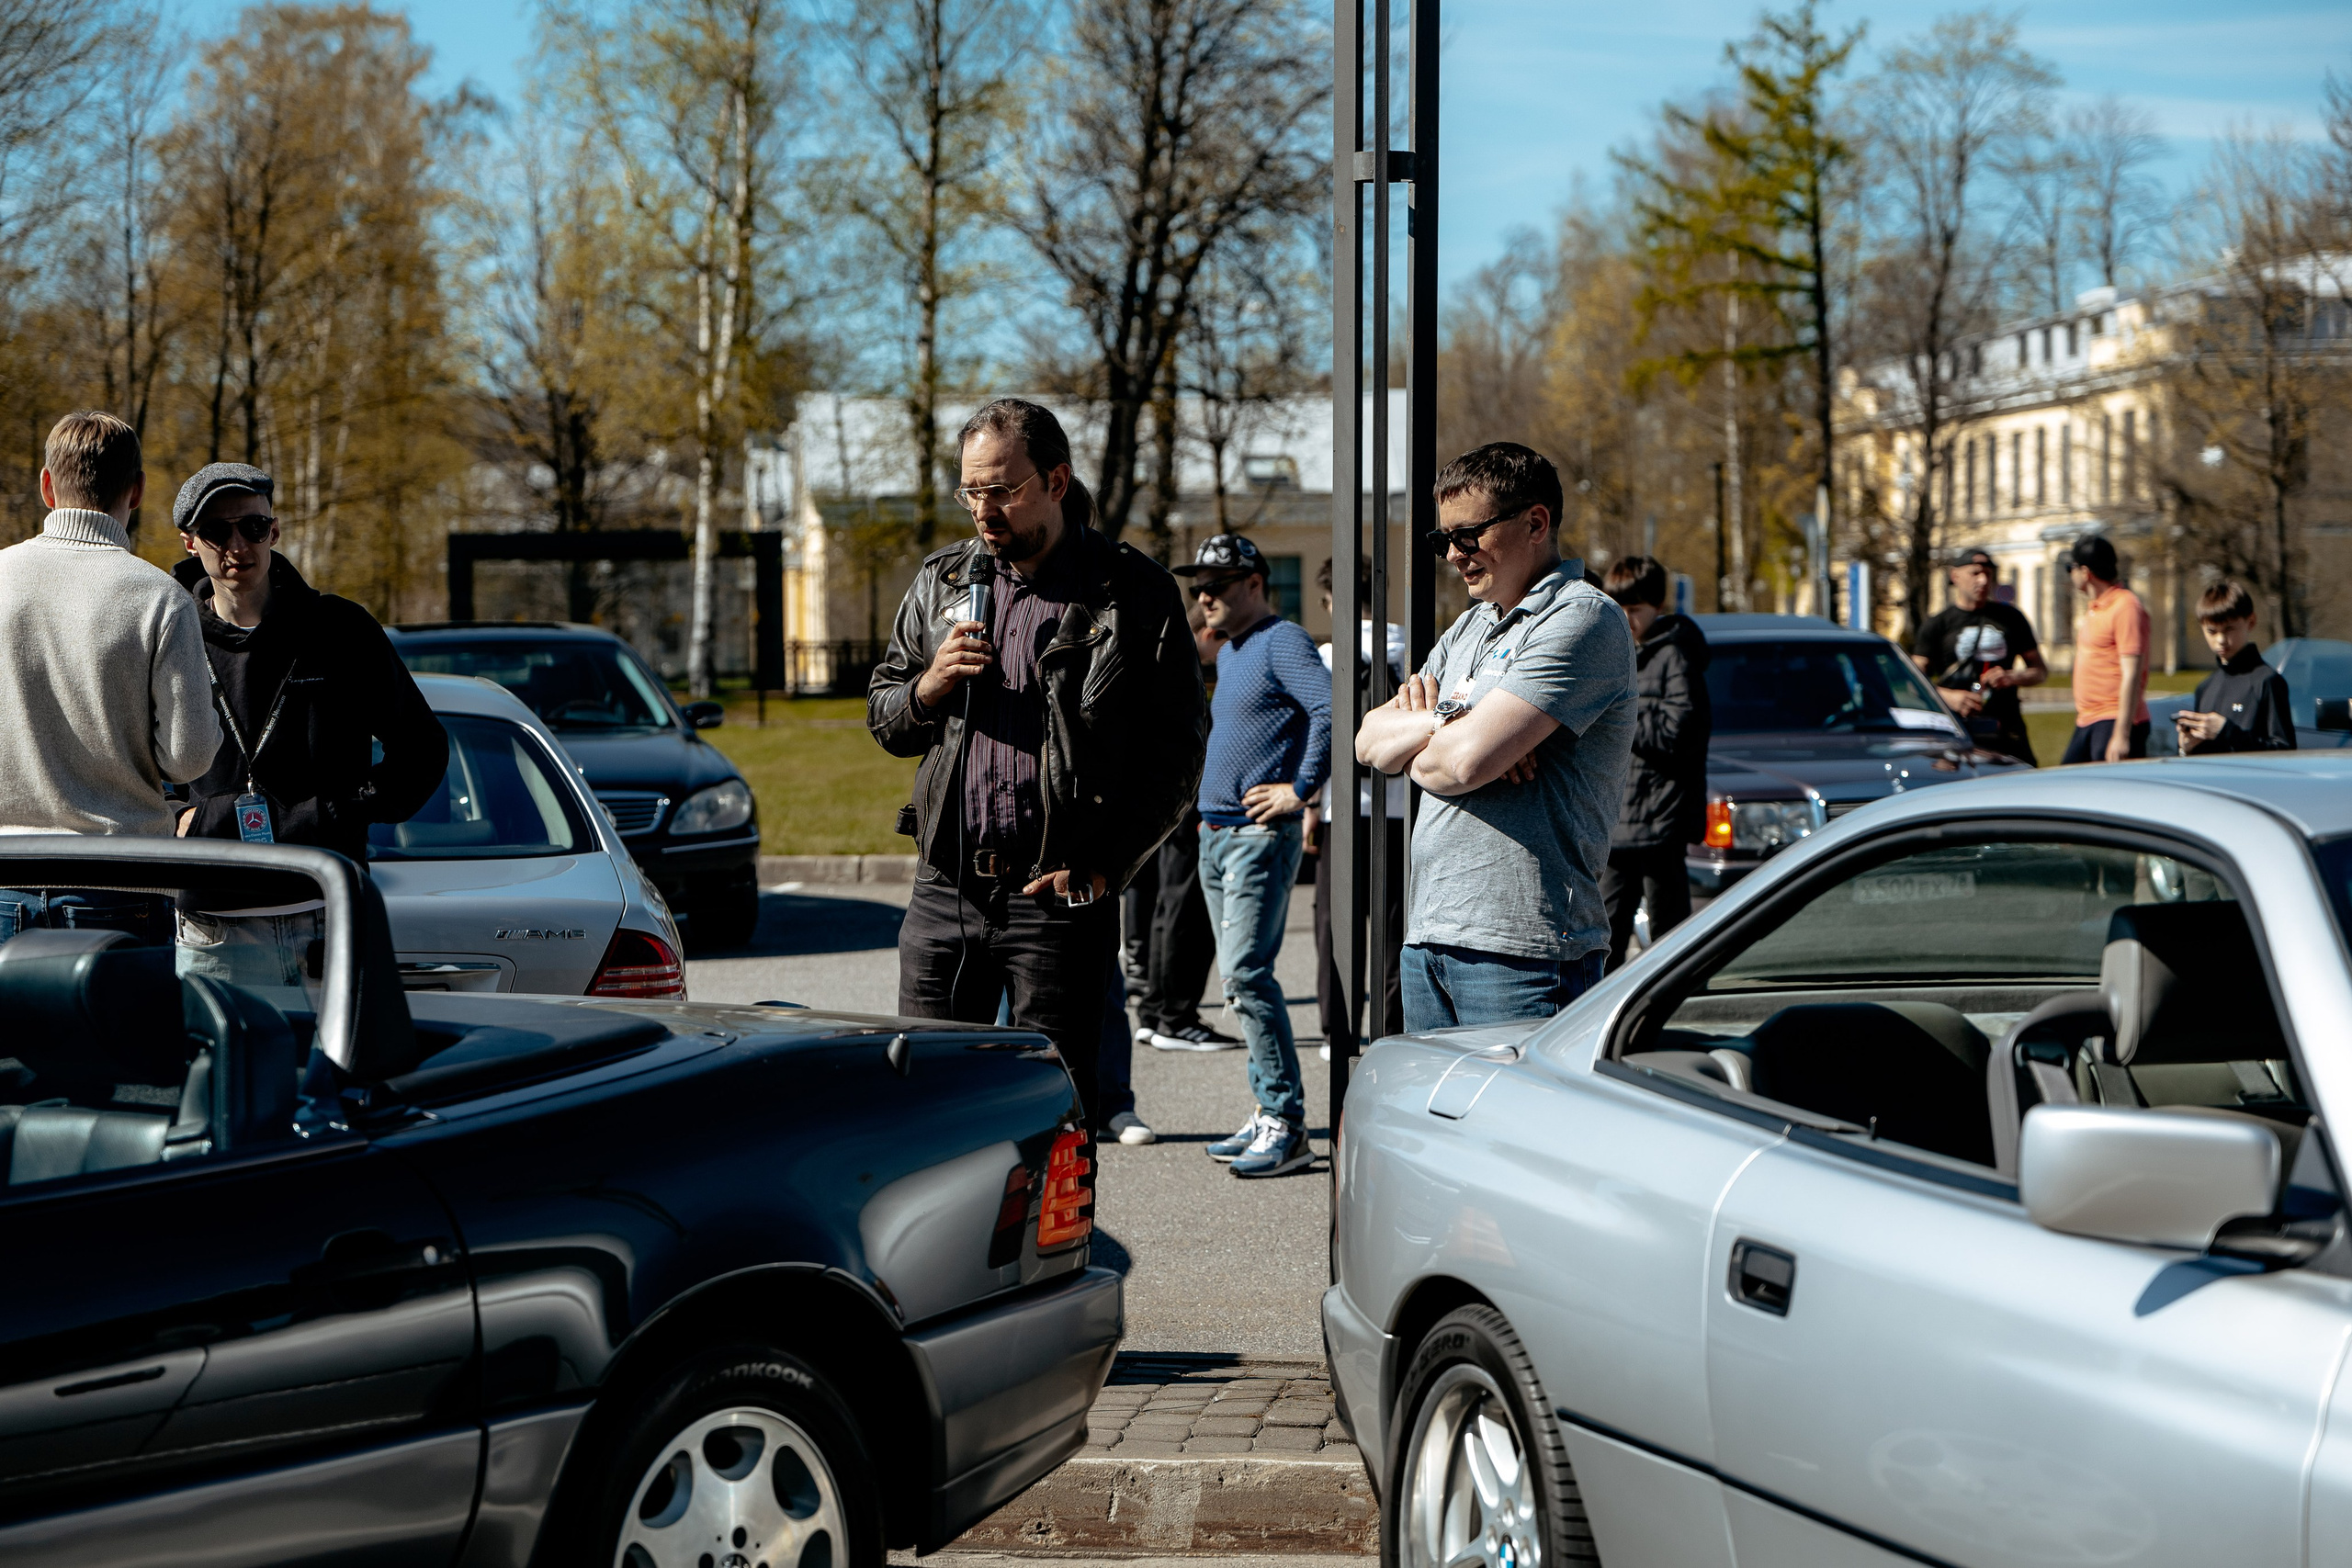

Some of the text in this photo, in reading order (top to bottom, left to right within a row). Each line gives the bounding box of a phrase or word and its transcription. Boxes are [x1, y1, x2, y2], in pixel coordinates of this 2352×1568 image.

[219, 694, 232, 719] Museum
[271, 694, 286, 719] Museum
[524, 928, 587, 941] AMG
